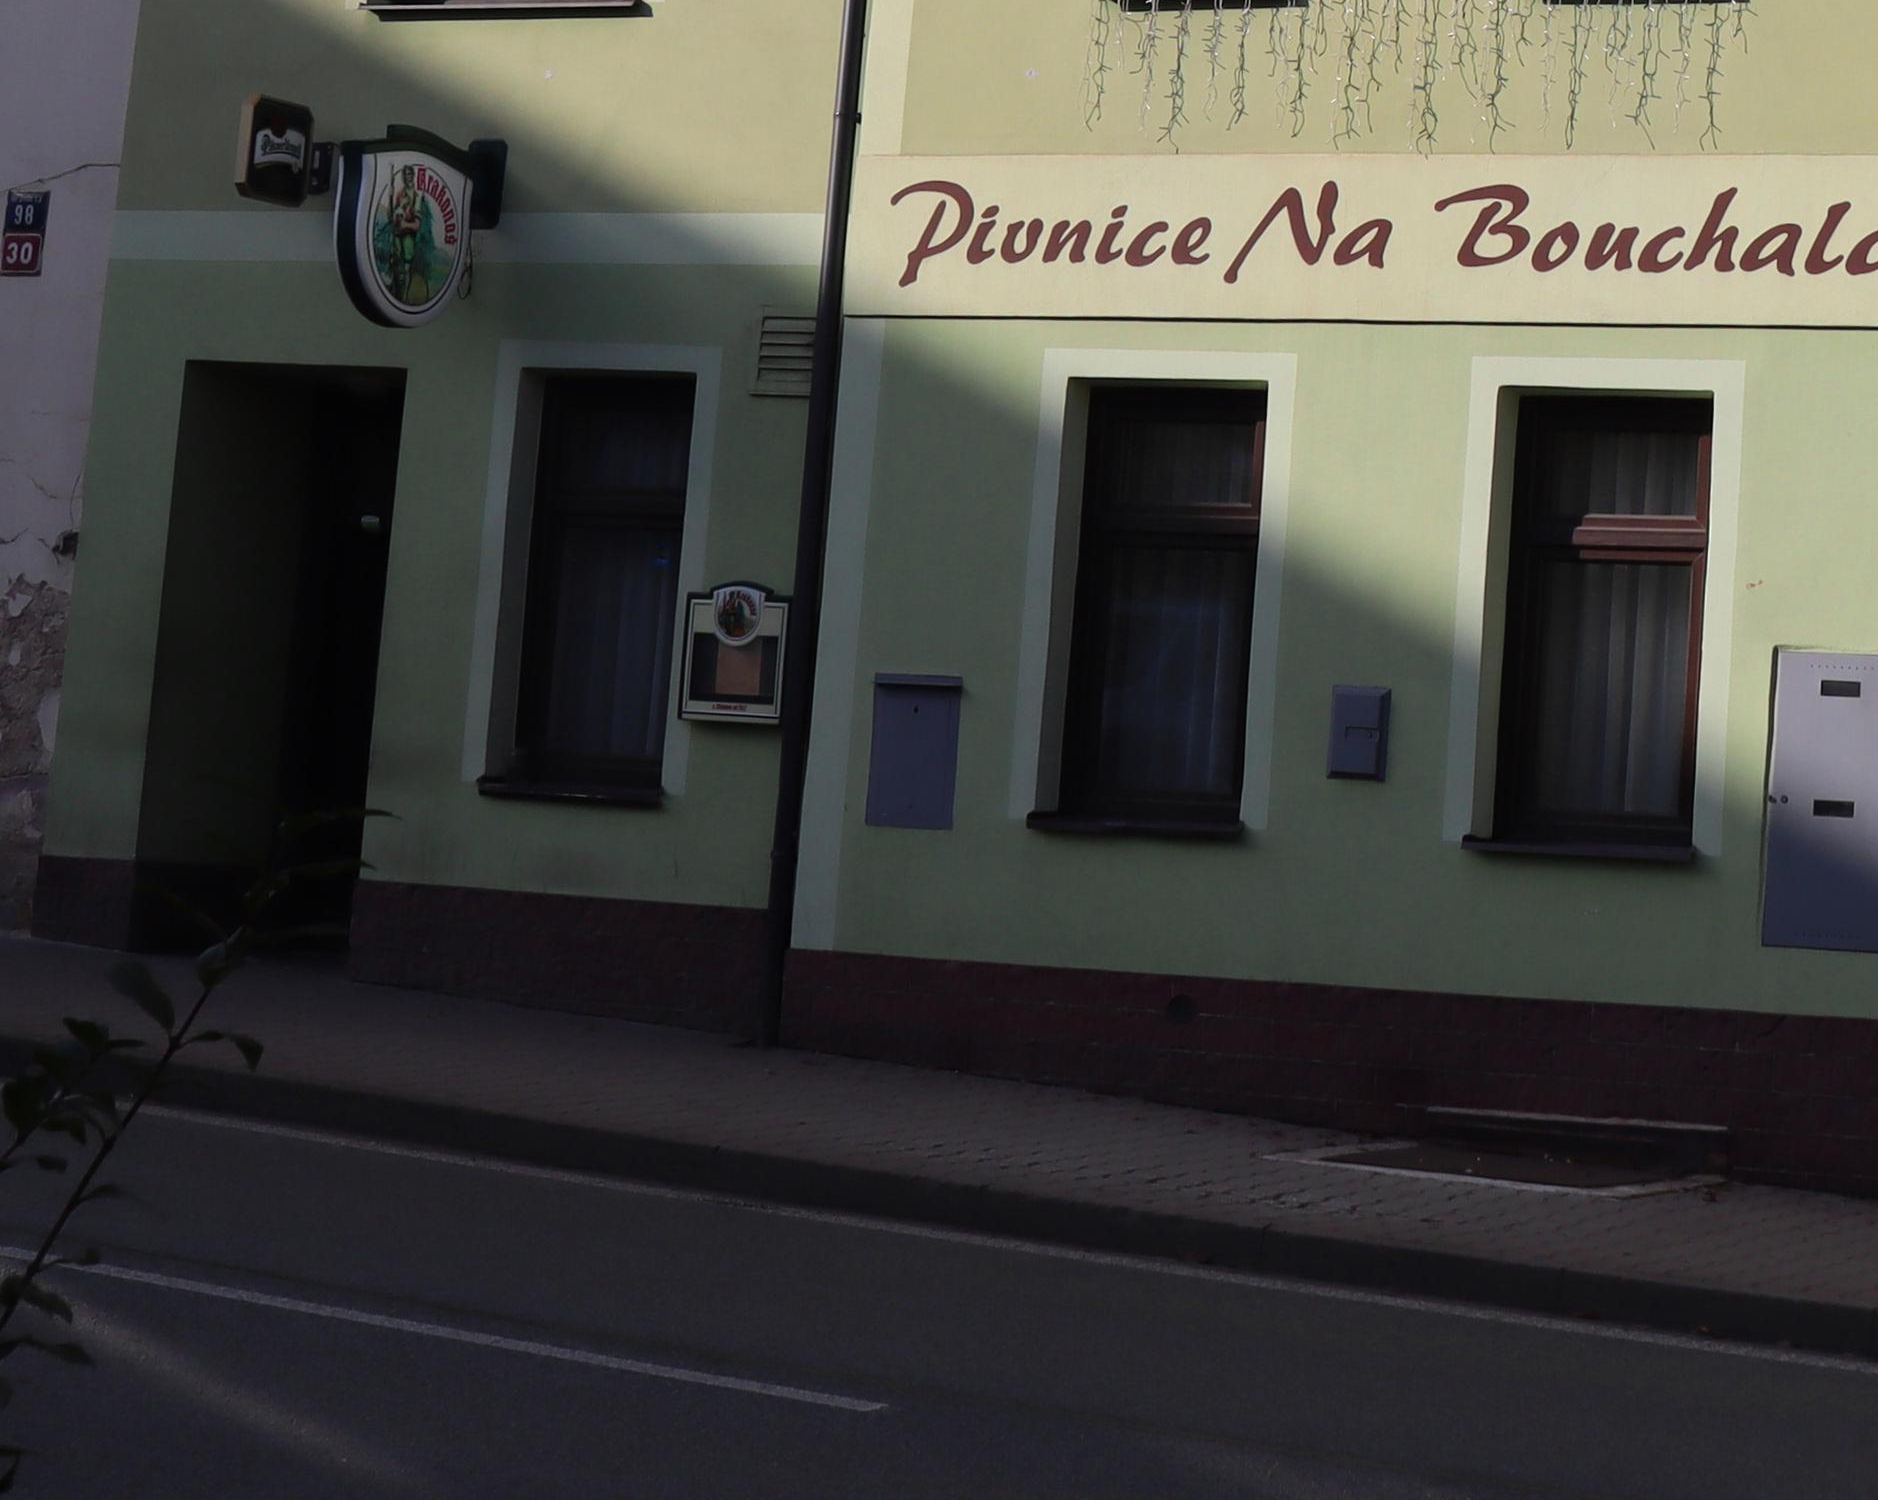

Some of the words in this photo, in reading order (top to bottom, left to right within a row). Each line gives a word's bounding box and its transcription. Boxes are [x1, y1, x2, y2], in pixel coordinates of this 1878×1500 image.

[14, 204, 34, 226] 98
[891, 180, 1211, 285] Pivnice
[1223, 182, 1391, 284] Na
[6, 242, 33, 265] 30
